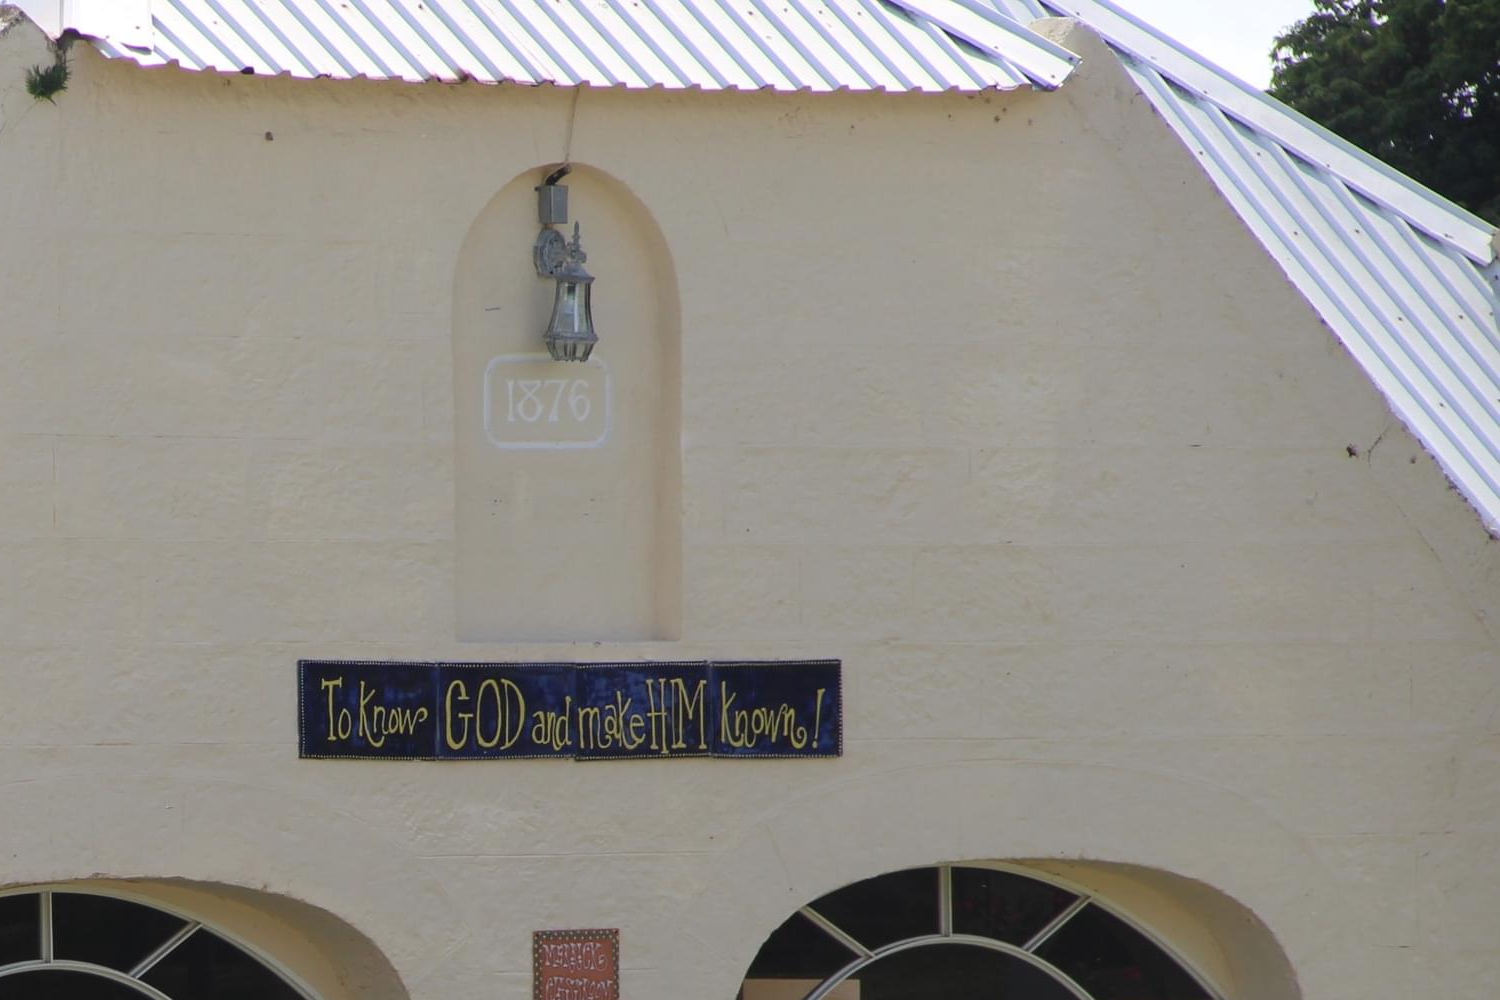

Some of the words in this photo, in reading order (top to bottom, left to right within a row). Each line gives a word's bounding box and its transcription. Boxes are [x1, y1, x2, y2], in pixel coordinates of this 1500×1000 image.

[506, 379, 591, 423] 1876
[321, 678, 351, 741] To
[445, 679, 526, 750] GOD
[532, 696, 572, 751] and
[646, 678, 708, 753] HIM
